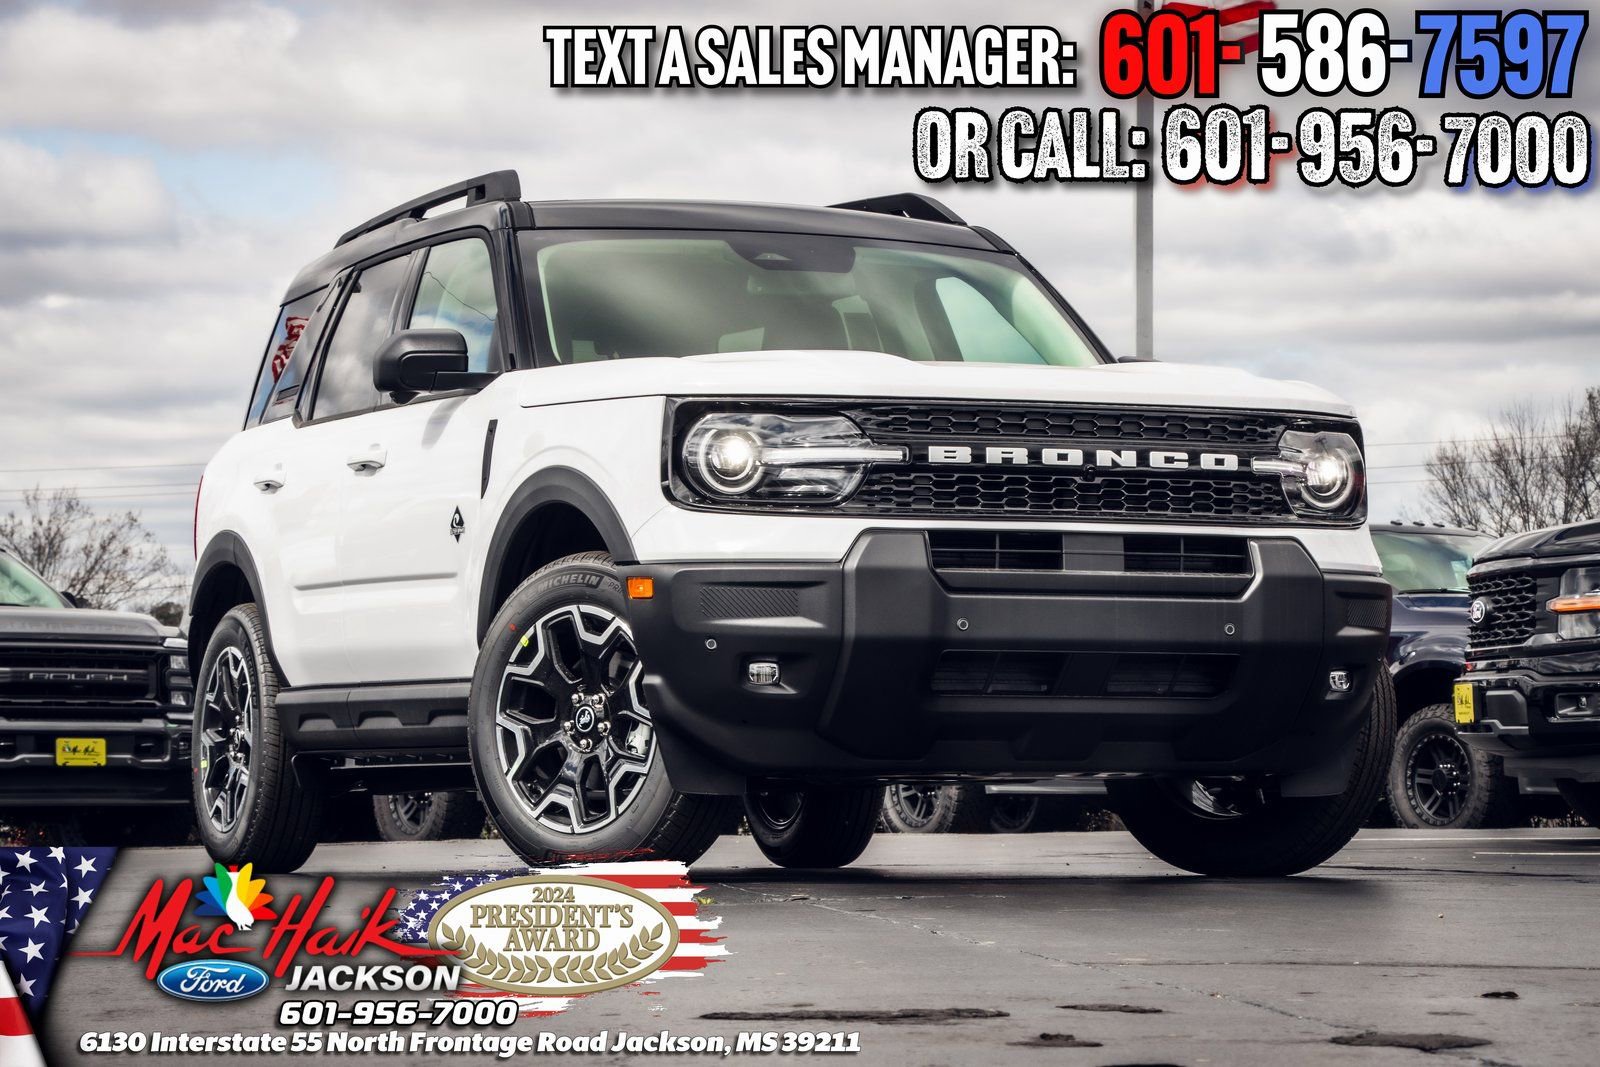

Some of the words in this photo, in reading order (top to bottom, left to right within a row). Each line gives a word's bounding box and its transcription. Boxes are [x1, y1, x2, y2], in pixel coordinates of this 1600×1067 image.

[927, 444, 1239, 472] BRONCO
[537, 573, 601, 593] MICHELIN
[29, 672, 127, 681] ROUSH
